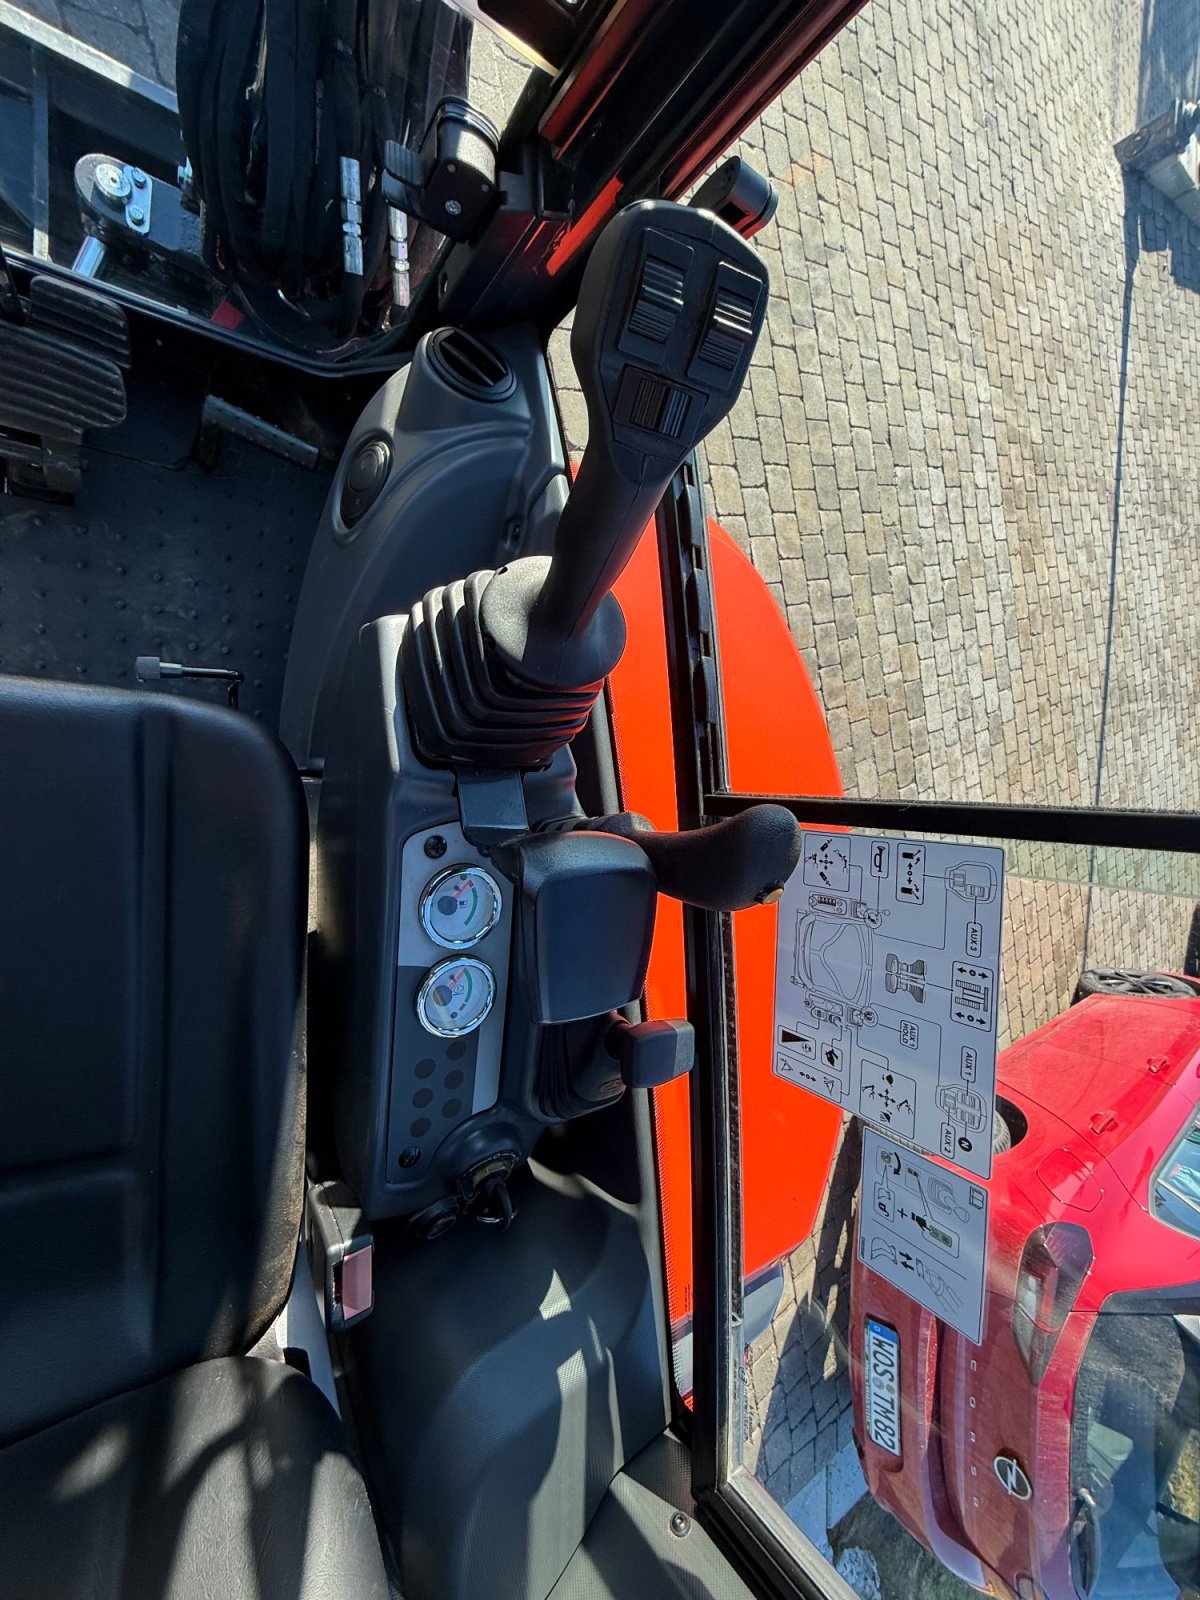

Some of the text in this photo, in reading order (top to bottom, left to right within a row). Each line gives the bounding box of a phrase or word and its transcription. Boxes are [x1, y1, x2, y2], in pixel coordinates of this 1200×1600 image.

[970, 927, 978, 945] AUX
[965, 1052, 973, 1071] AUX
[944, 1128, 952, 1147] AUX
[872, 1336, 895, 1383] WOS
